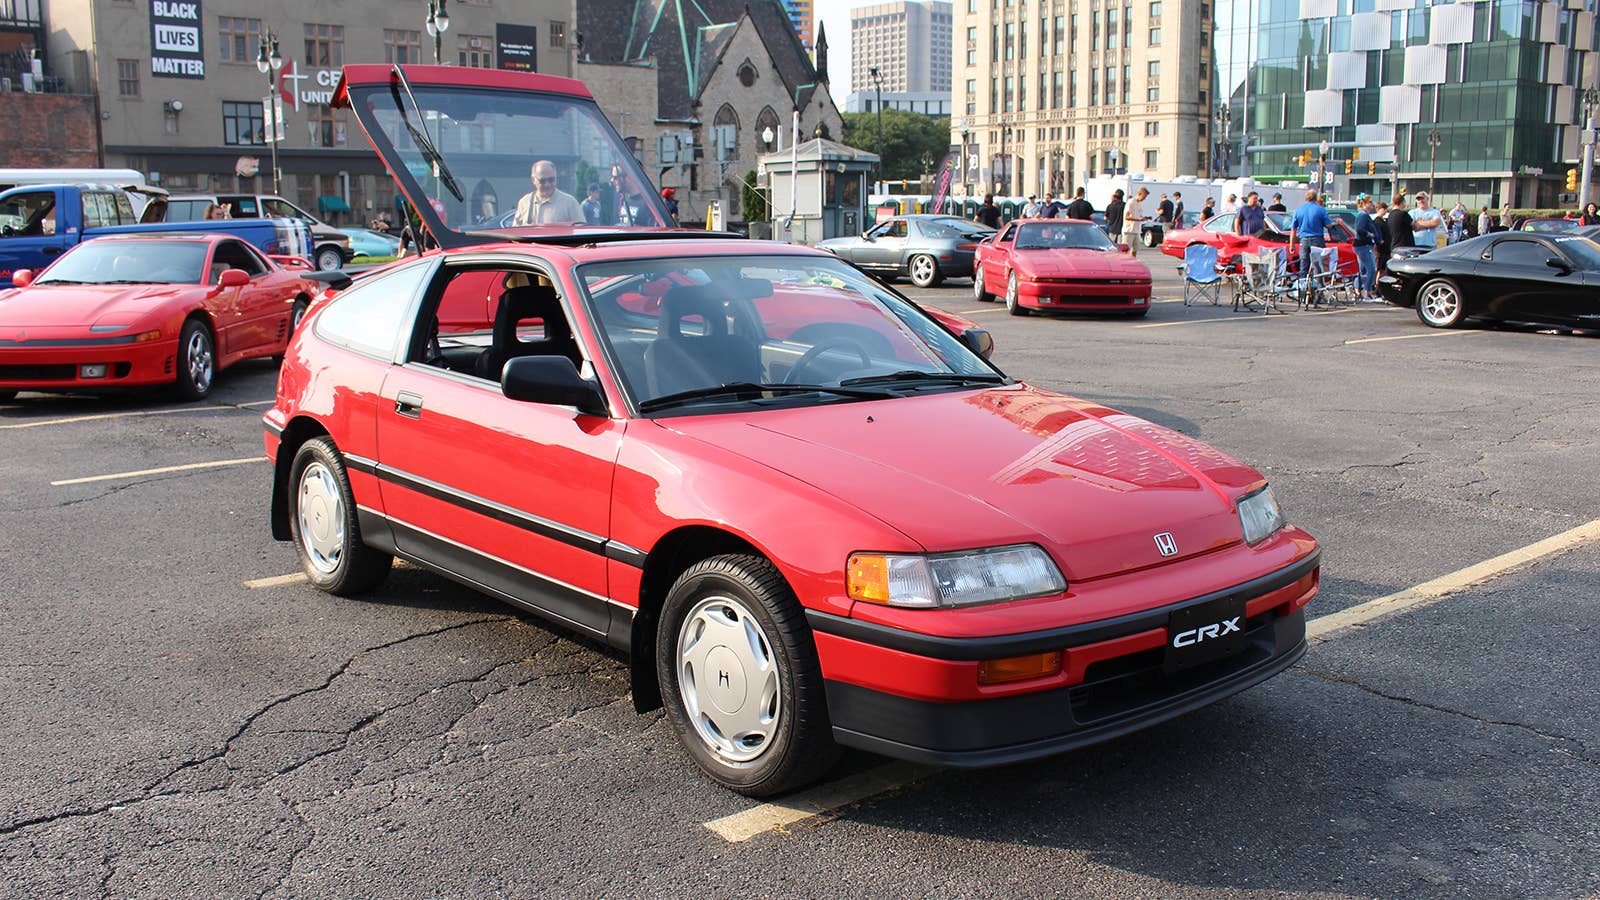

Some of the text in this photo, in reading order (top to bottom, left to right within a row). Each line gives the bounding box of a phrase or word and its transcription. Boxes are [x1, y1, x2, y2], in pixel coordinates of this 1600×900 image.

[153, 1, 198, 19] BLACK
[159, 30, 195, 46] LIVES
[152, 57, 204, 75] MATTER
[1173, 616, 1240, 648] CRX
